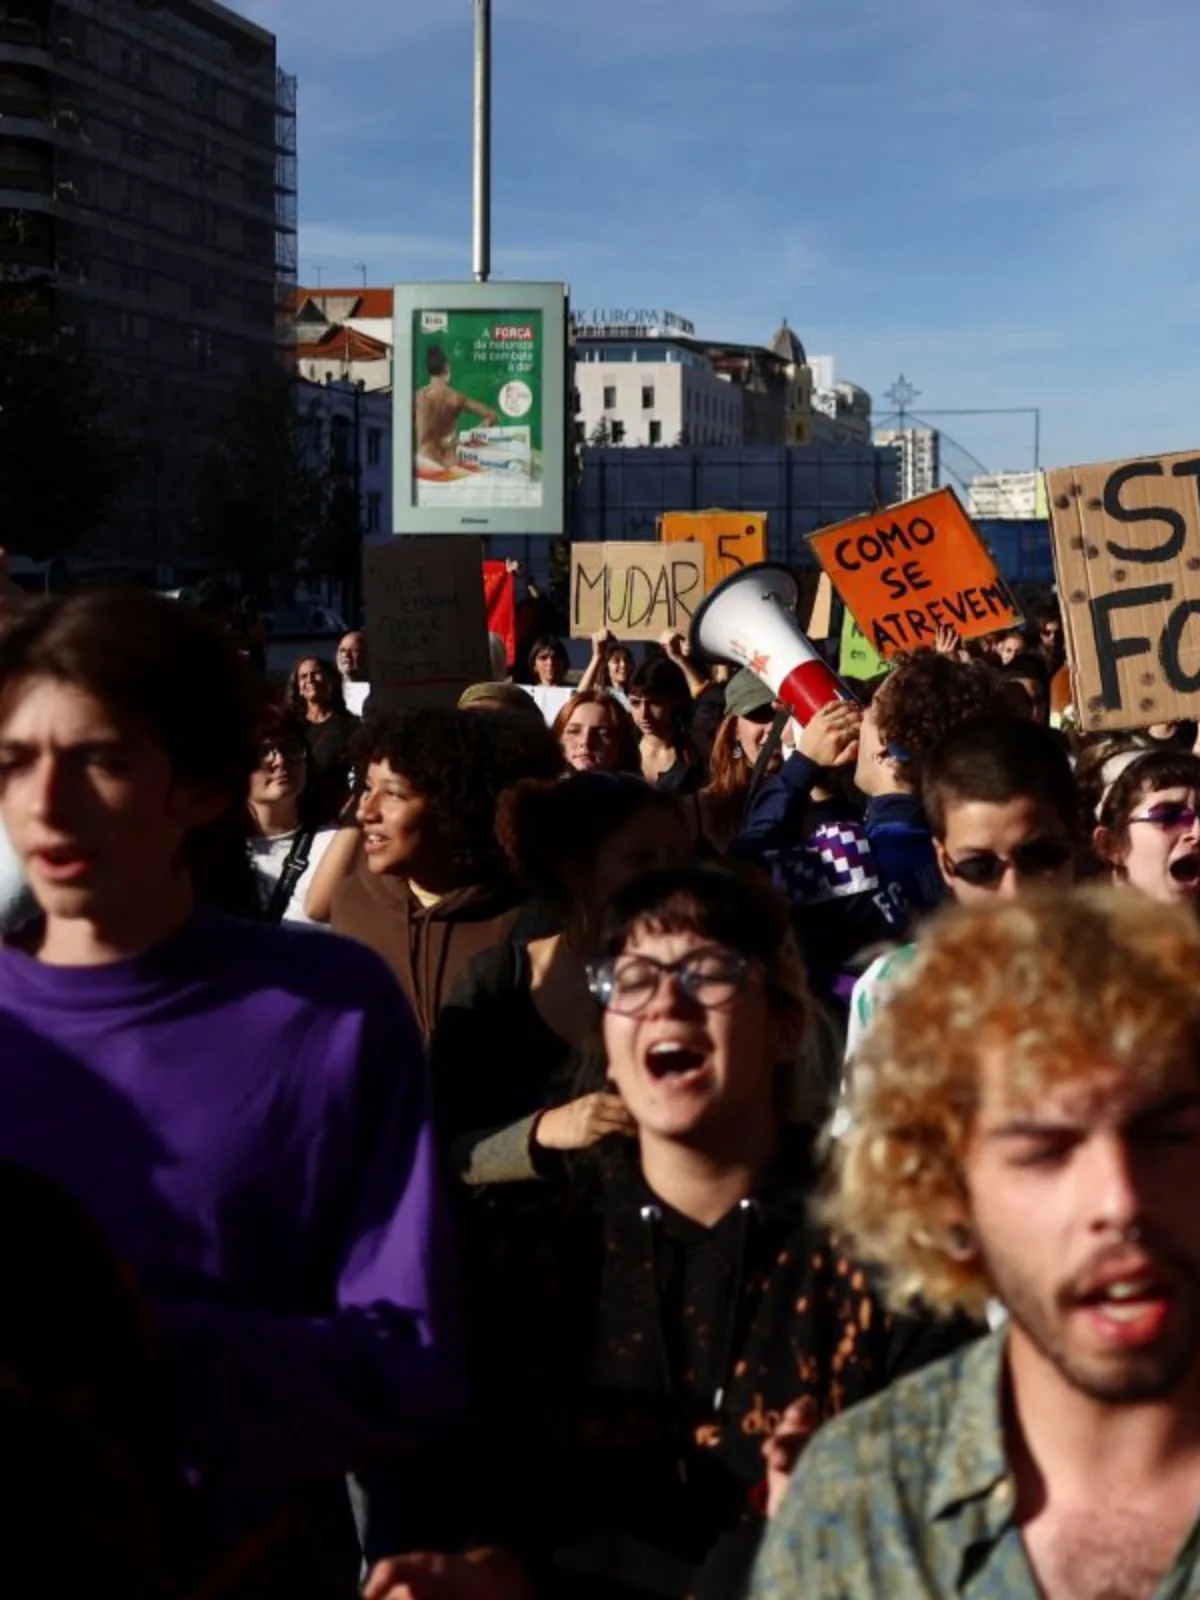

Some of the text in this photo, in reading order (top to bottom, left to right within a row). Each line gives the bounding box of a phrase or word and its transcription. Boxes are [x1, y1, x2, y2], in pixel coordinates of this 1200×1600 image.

[495, 327, 532, 341] FORÇA
[592, 309, 659, 323] EUROPA
[835, 517, 935, 571] COMO
[575, 561, 699, 628] MUDAR
[880, 560, 932, 600] SE
